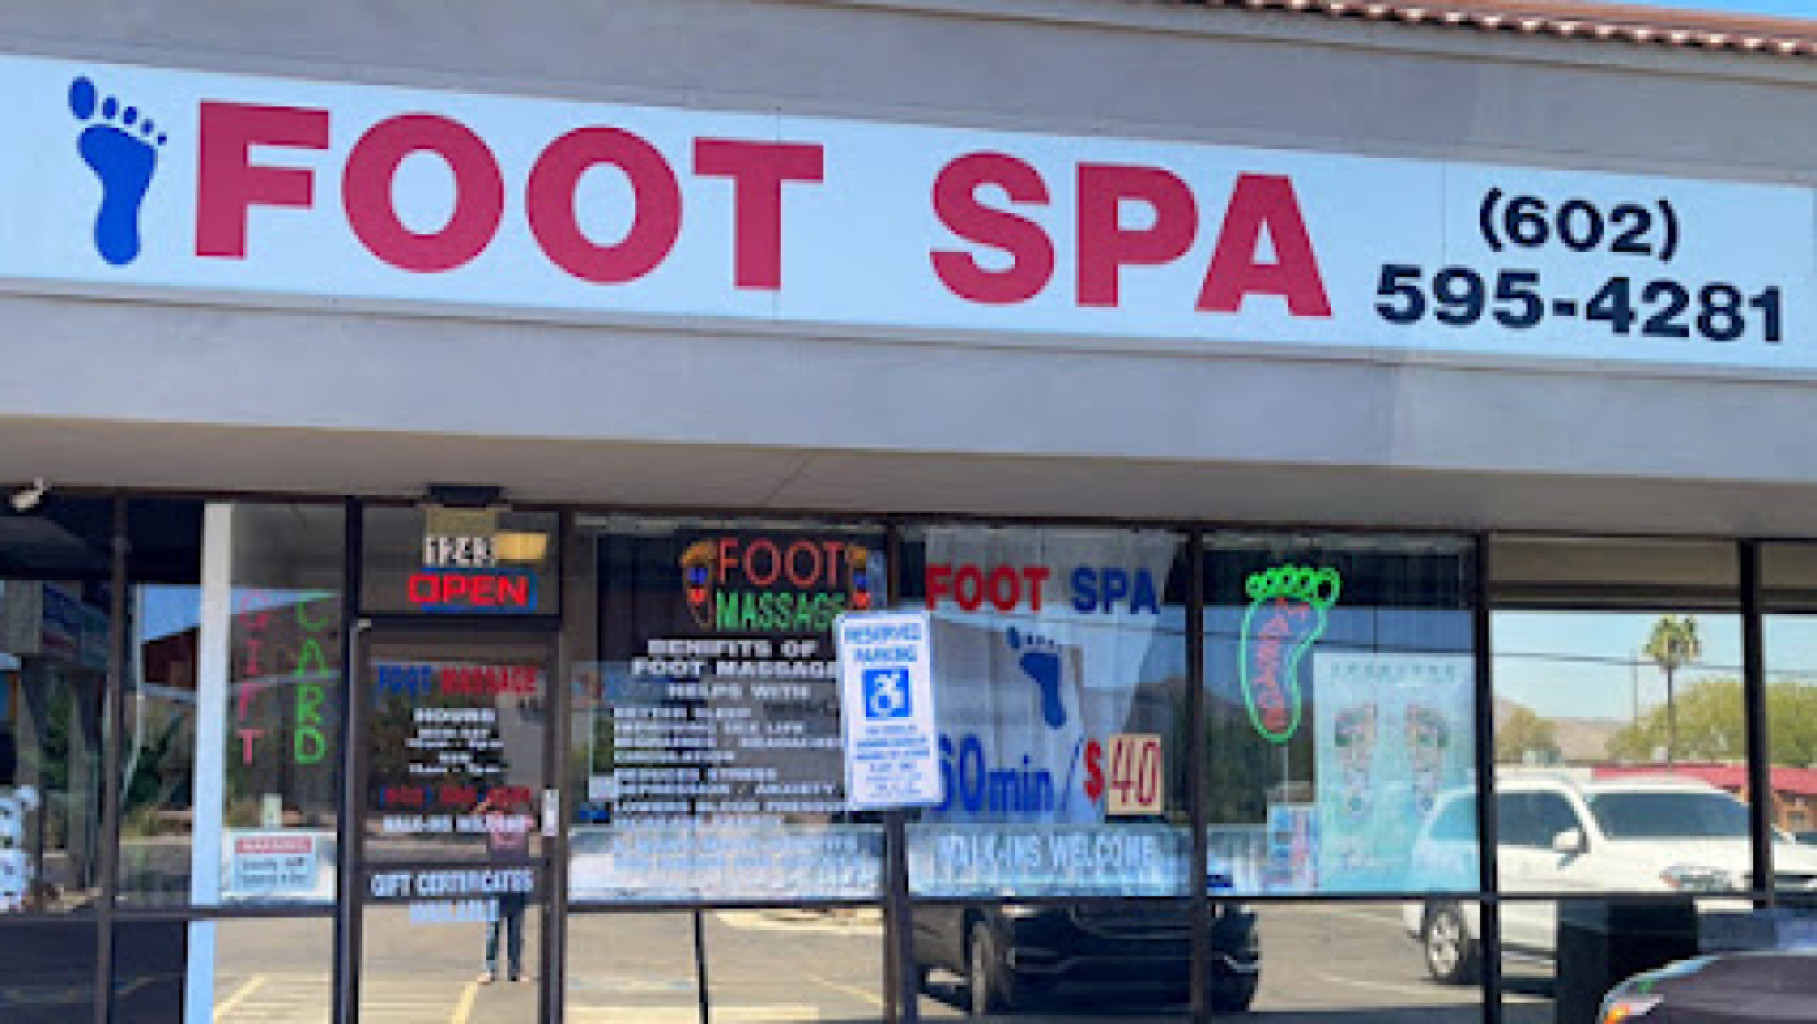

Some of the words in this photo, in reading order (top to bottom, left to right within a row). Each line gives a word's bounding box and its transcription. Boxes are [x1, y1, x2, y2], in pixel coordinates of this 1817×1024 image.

[194, 98, 825, 291] FOOT
[929, 149, 1333, 318] SPA
[1479, 185, 1680, 263] (602)
[1373, 264, 1784, 343] 595-4281
[716, 538, 845, 587] FOOT
[408, 573, 529, 607] OPEN
[925, 562, 1052, 613] FOOT
[1070, 564, 1161, 615] SPA
[716, 591, 846, 632] MASSAGE
[631, 657, 702, 676] FOOT
[780, 640, 819, 657] OF
[237, 588, 270, 766] GIFT
[293, 586, 335, 765] CARD
[378, 664, 433, 696] FOOT
[442, 665, 539, 695] MASSAGE
[667, 682, 742, 699] HELPS
[750, 684, 811, 699] WITH
[412, 707, 497, 722] HOURS
[370, 873, 412, 897] GIFT
